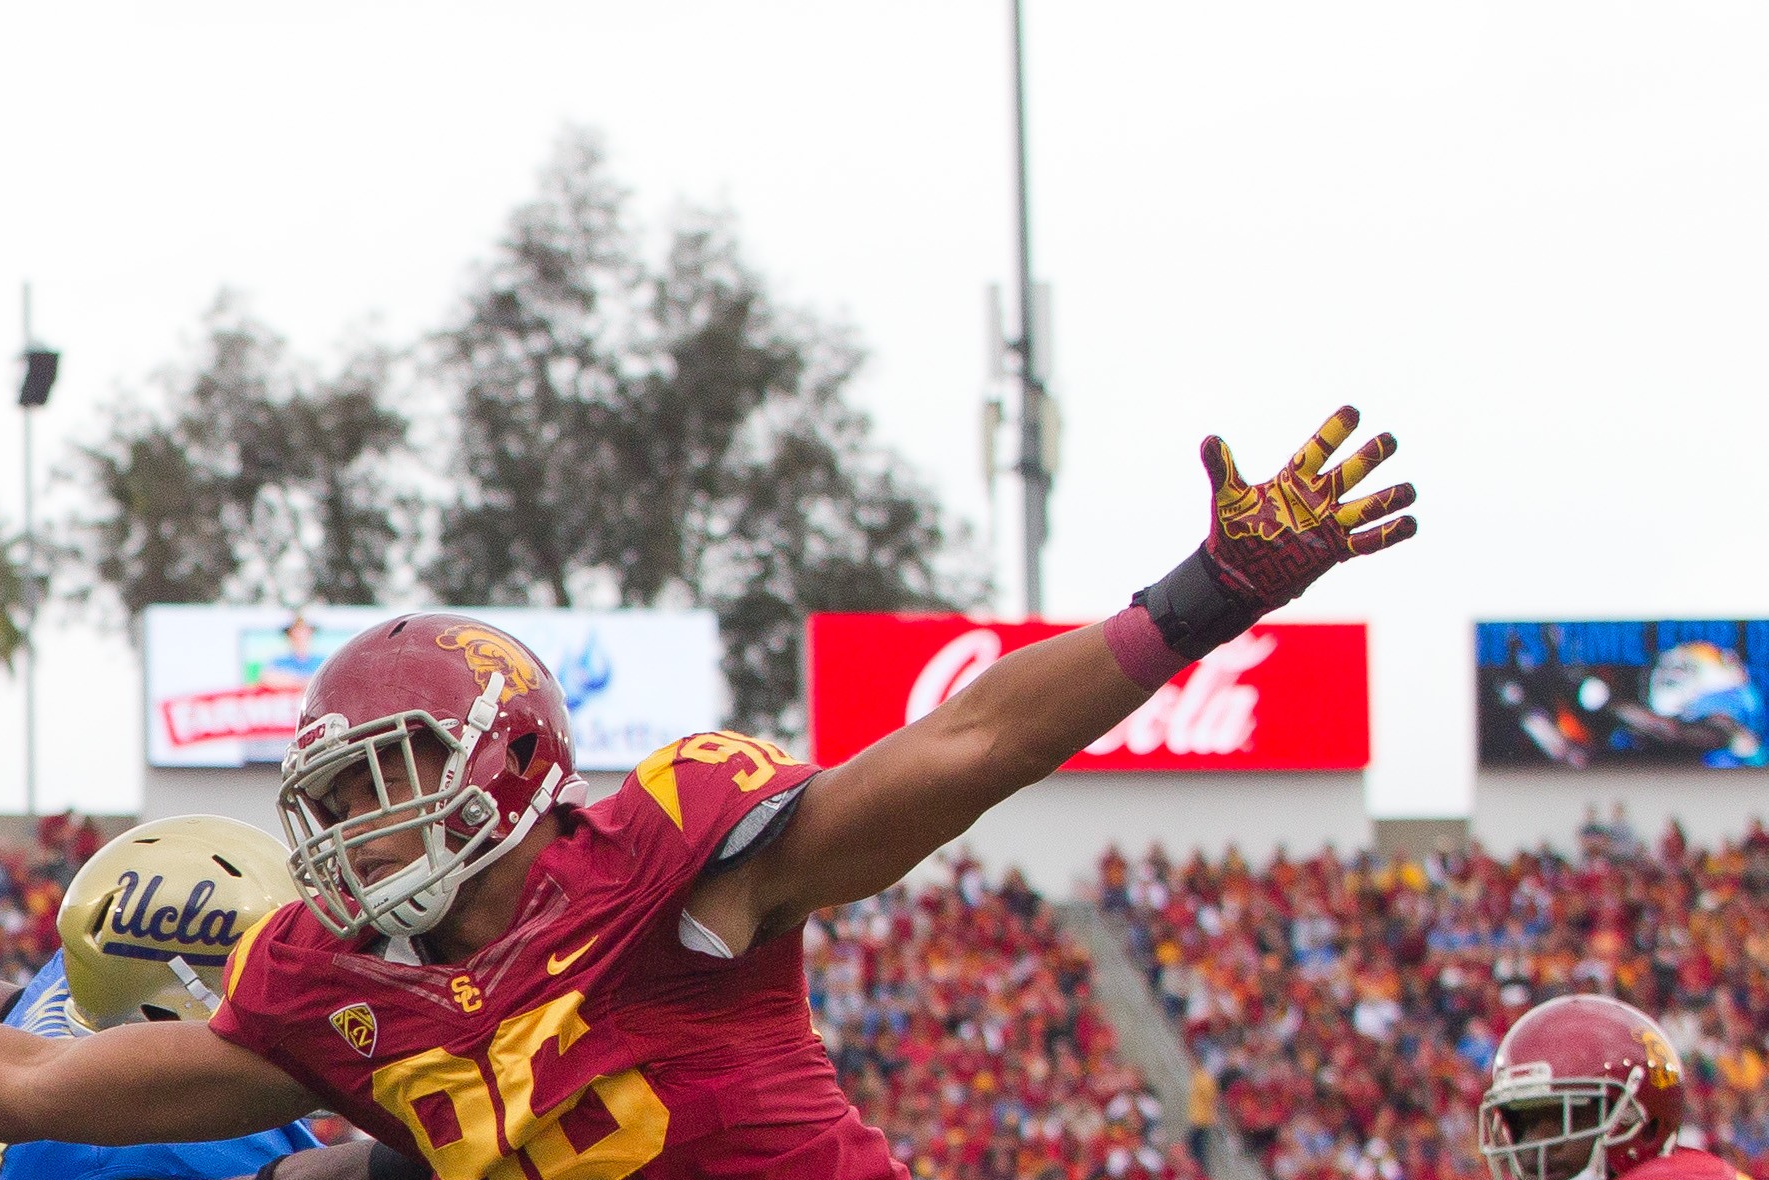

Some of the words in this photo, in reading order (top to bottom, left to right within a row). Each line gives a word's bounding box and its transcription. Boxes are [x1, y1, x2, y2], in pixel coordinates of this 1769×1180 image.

[450, 974, 483, 1013] SC
[332, 1006, 375, 1039] PAC
[349, 1025, 373, 1049] 12
